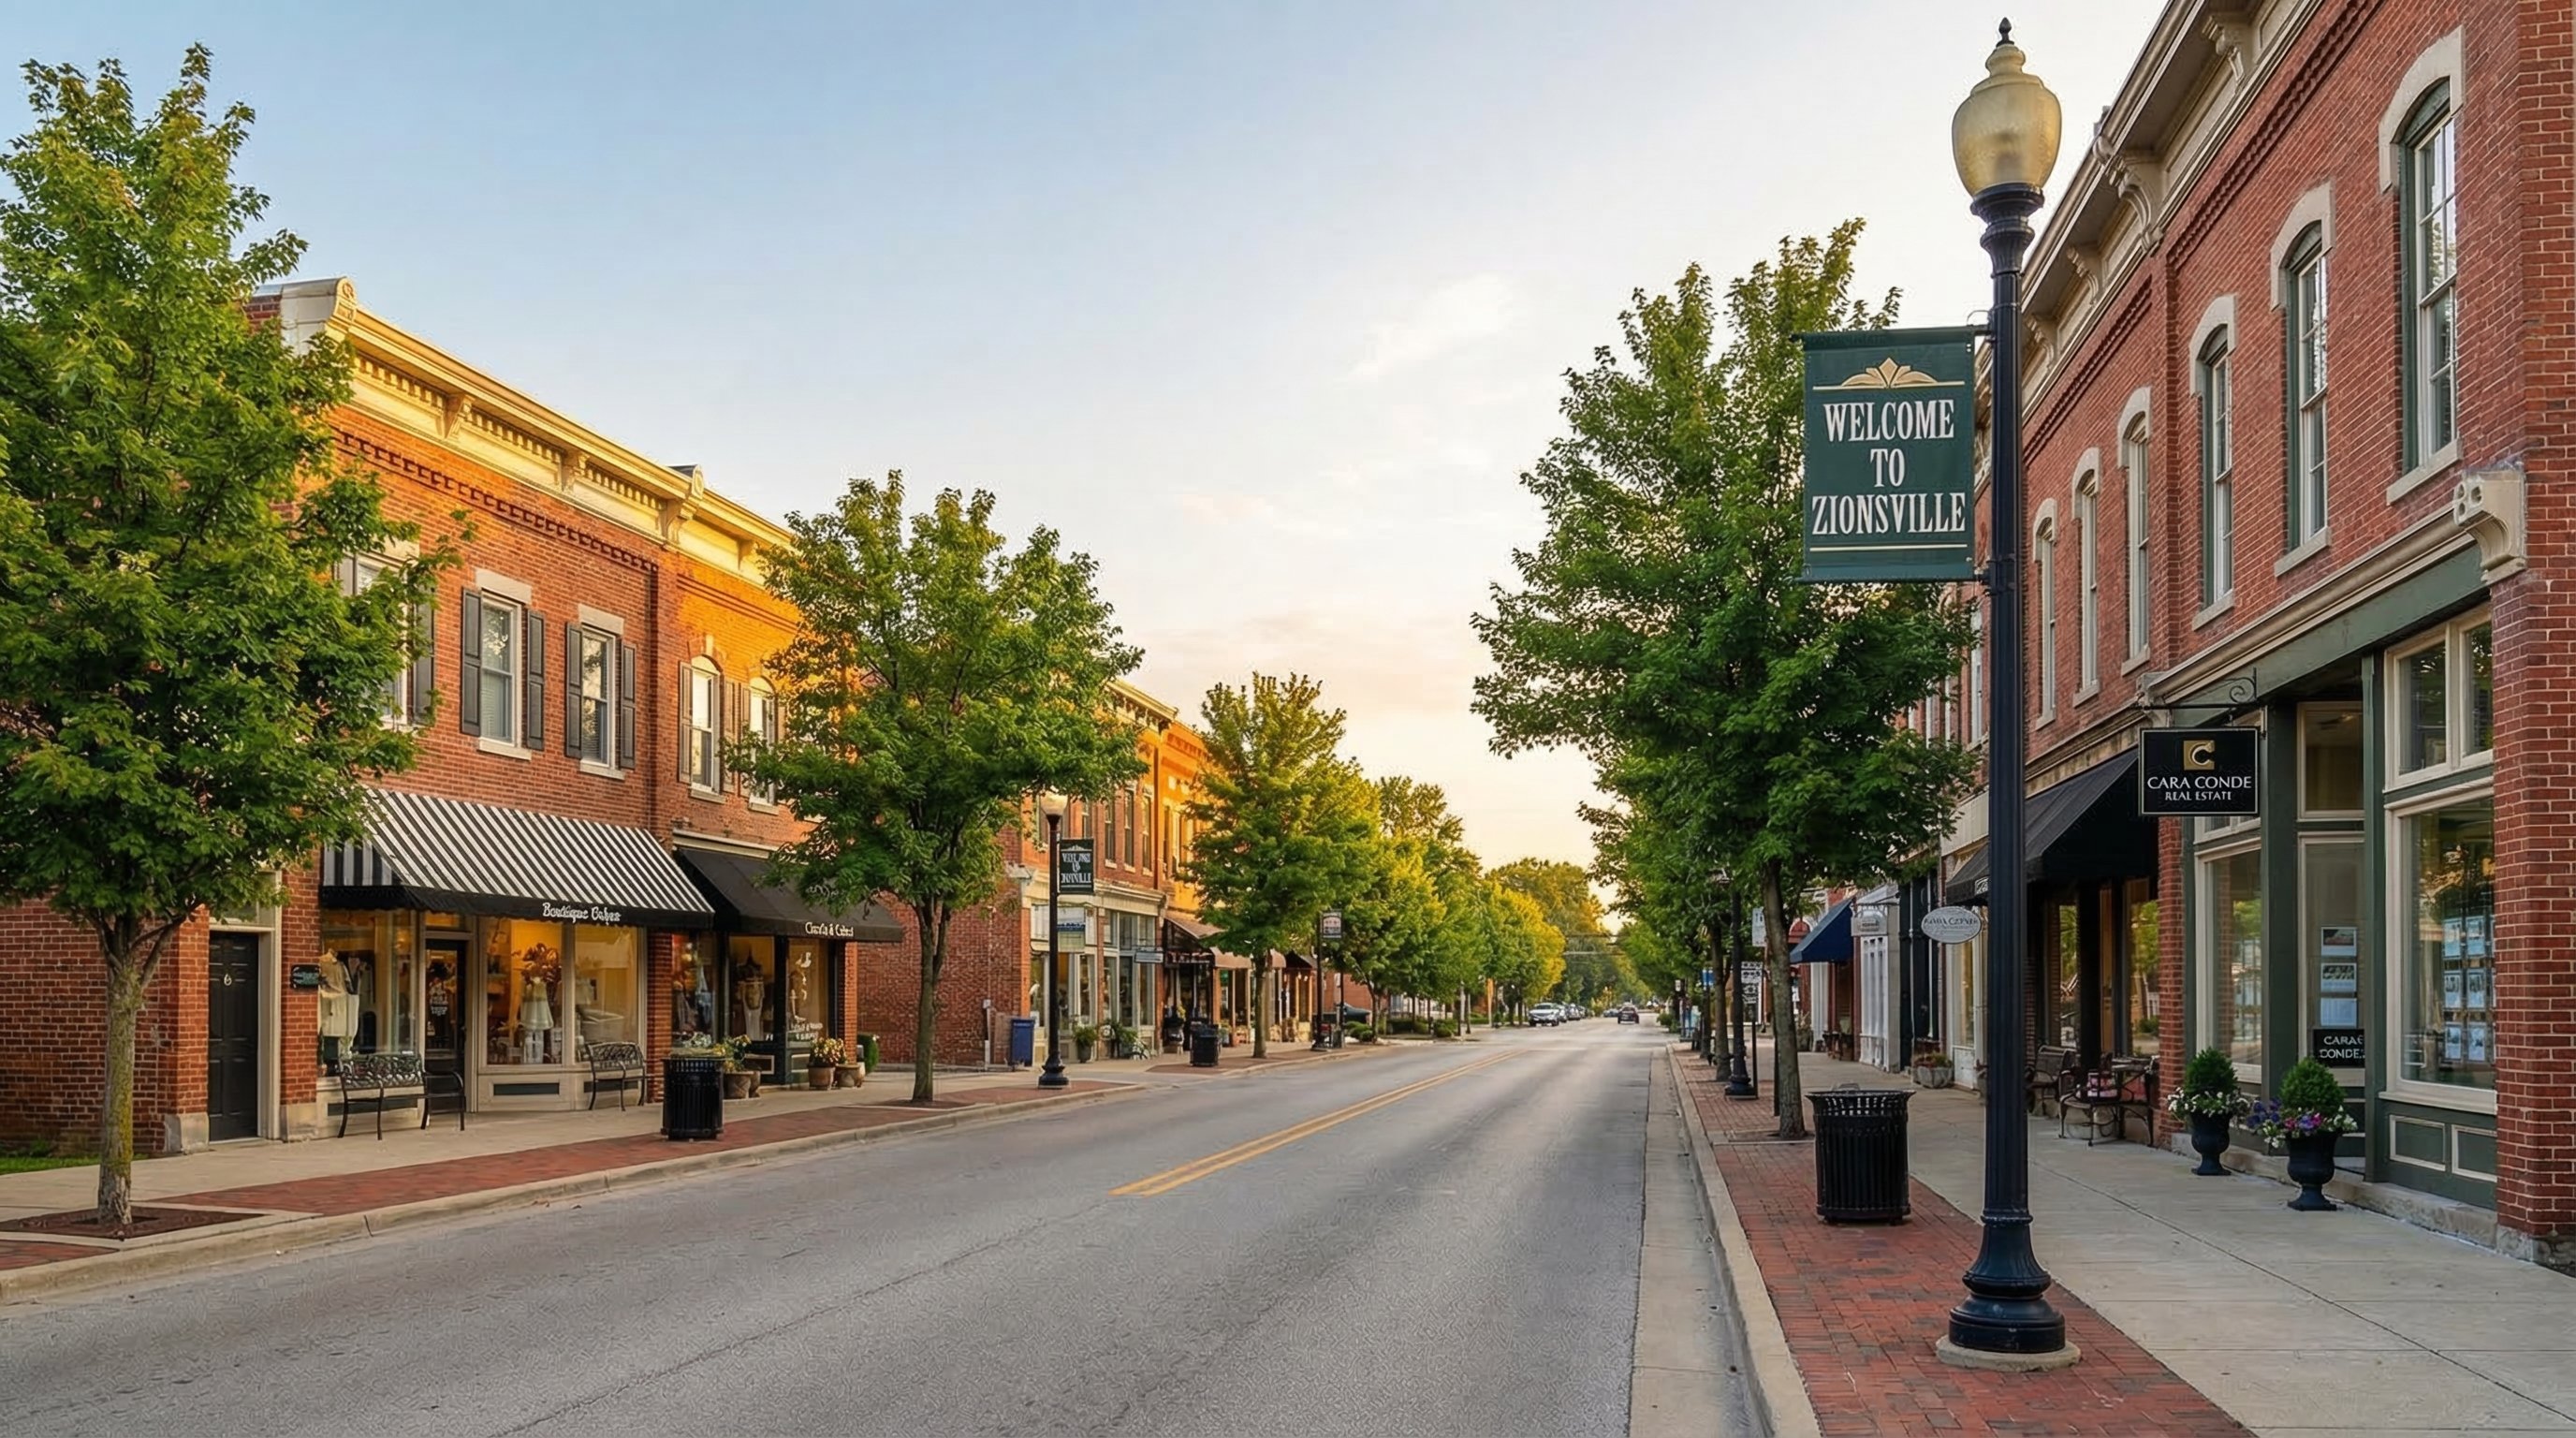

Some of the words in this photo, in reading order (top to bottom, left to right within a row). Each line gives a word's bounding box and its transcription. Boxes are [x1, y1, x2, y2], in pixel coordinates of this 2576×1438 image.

[1823, 400, 1954, 442] WELCOME
[1870, 448, 1905, 487] TO
[1812, 492, 1966, 535] ZIONSVILLE
[2147, 776, 2190, 789] CARA
[2194, 776, 2251, 788] CONDE
[2165, 791, 2191, 800] REAL
[2195, 791, 2232, 800] ESTATE
[224, 974, 232, 986] 6
